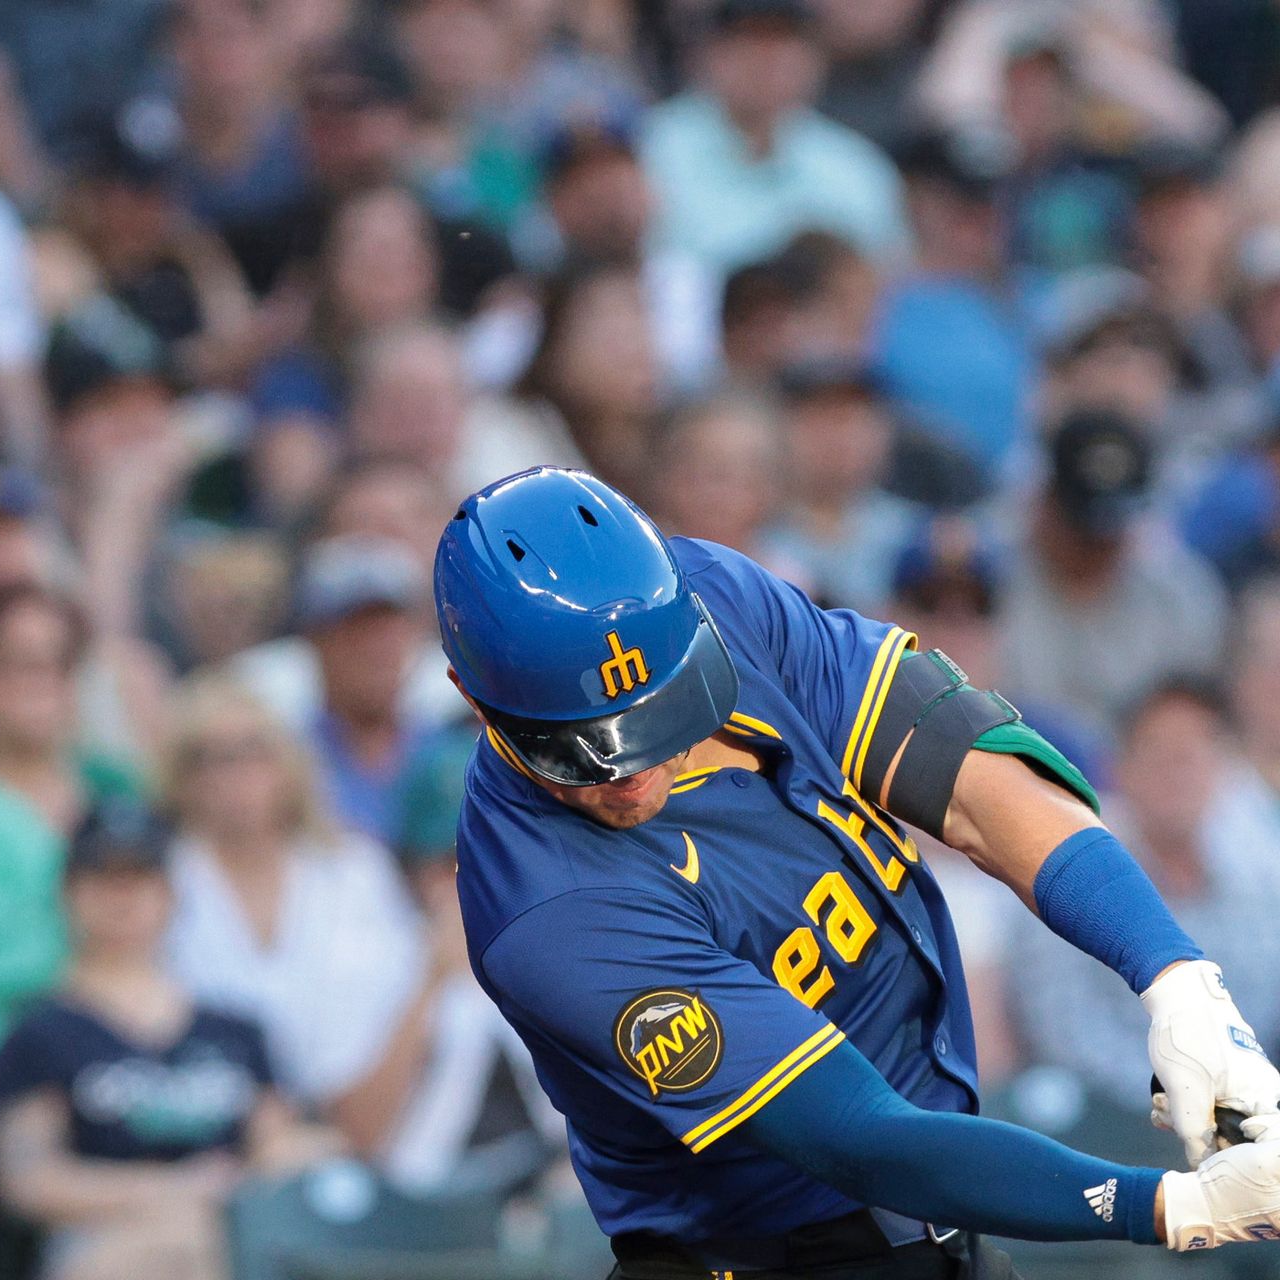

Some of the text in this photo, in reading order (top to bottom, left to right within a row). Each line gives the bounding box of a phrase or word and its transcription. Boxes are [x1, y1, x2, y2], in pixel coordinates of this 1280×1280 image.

[772, 777, 919, 1009] eatt
[635, 996, 707, 1095] PNW
[1102, 1178, 1117, 1223] adidas
